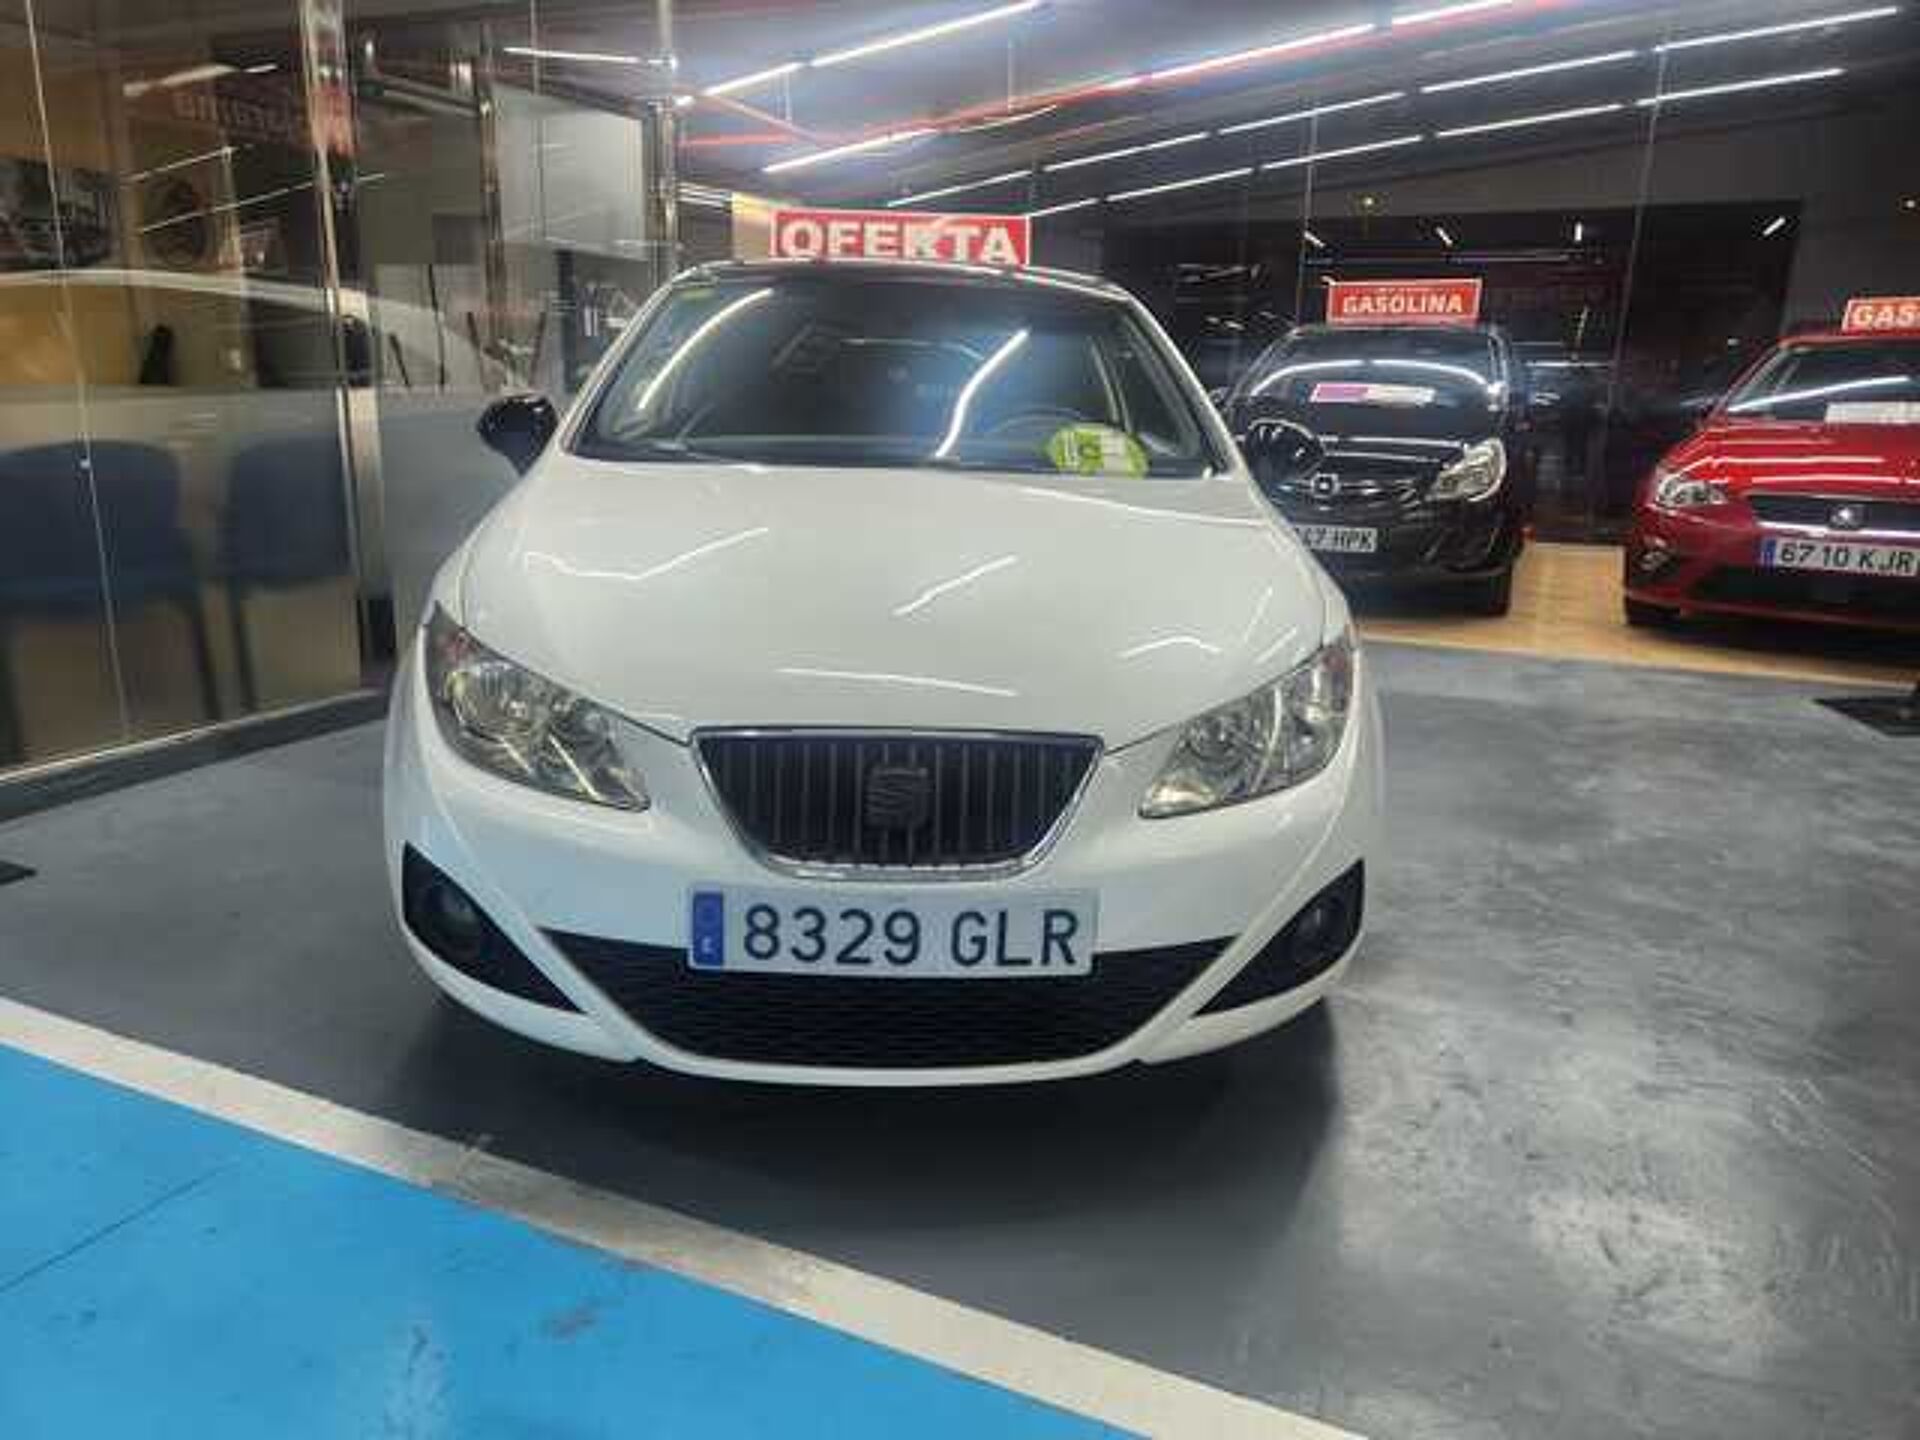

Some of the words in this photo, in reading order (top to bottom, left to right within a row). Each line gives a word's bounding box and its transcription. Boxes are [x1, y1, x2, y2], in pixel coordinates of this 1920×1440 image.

[779, 219, 1018, 265] OFERTA
[1342, 293, 1463, 313] GASOLINA
[1780, 543, 1850, 567] 6710
[1858, 549, 1914, 573] KJR
[743, 903, 921, 966] 8329
[950, 907, 1080, 967] GLR
